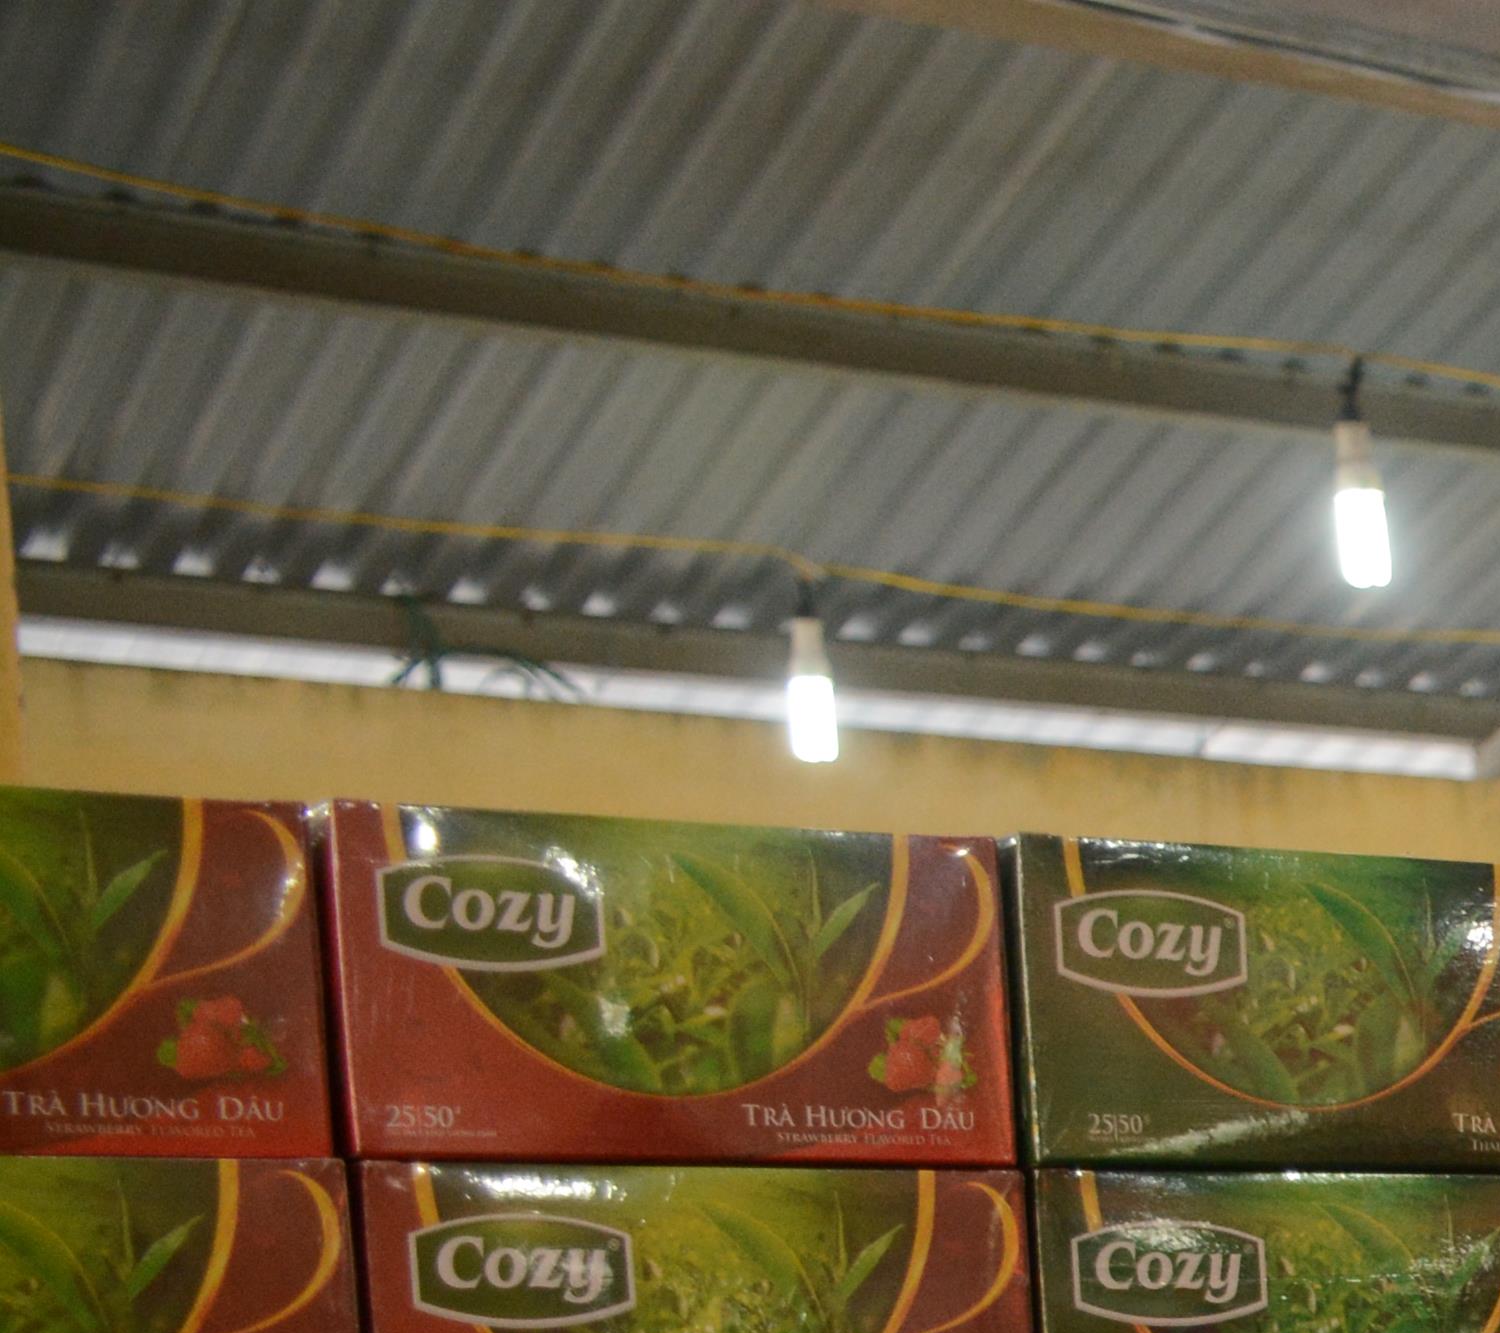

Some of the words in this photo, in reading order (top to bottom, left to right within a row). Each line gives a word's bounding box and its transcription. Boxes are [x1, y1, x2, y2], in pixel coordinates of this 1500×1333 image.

[402, 877, 576, 948] Cozy
[1078, 908, 1224, 976] Cozy
[436, 1236, 608, 1300] Cozy
[1096, 1240, 1242, 1304] Cozy
